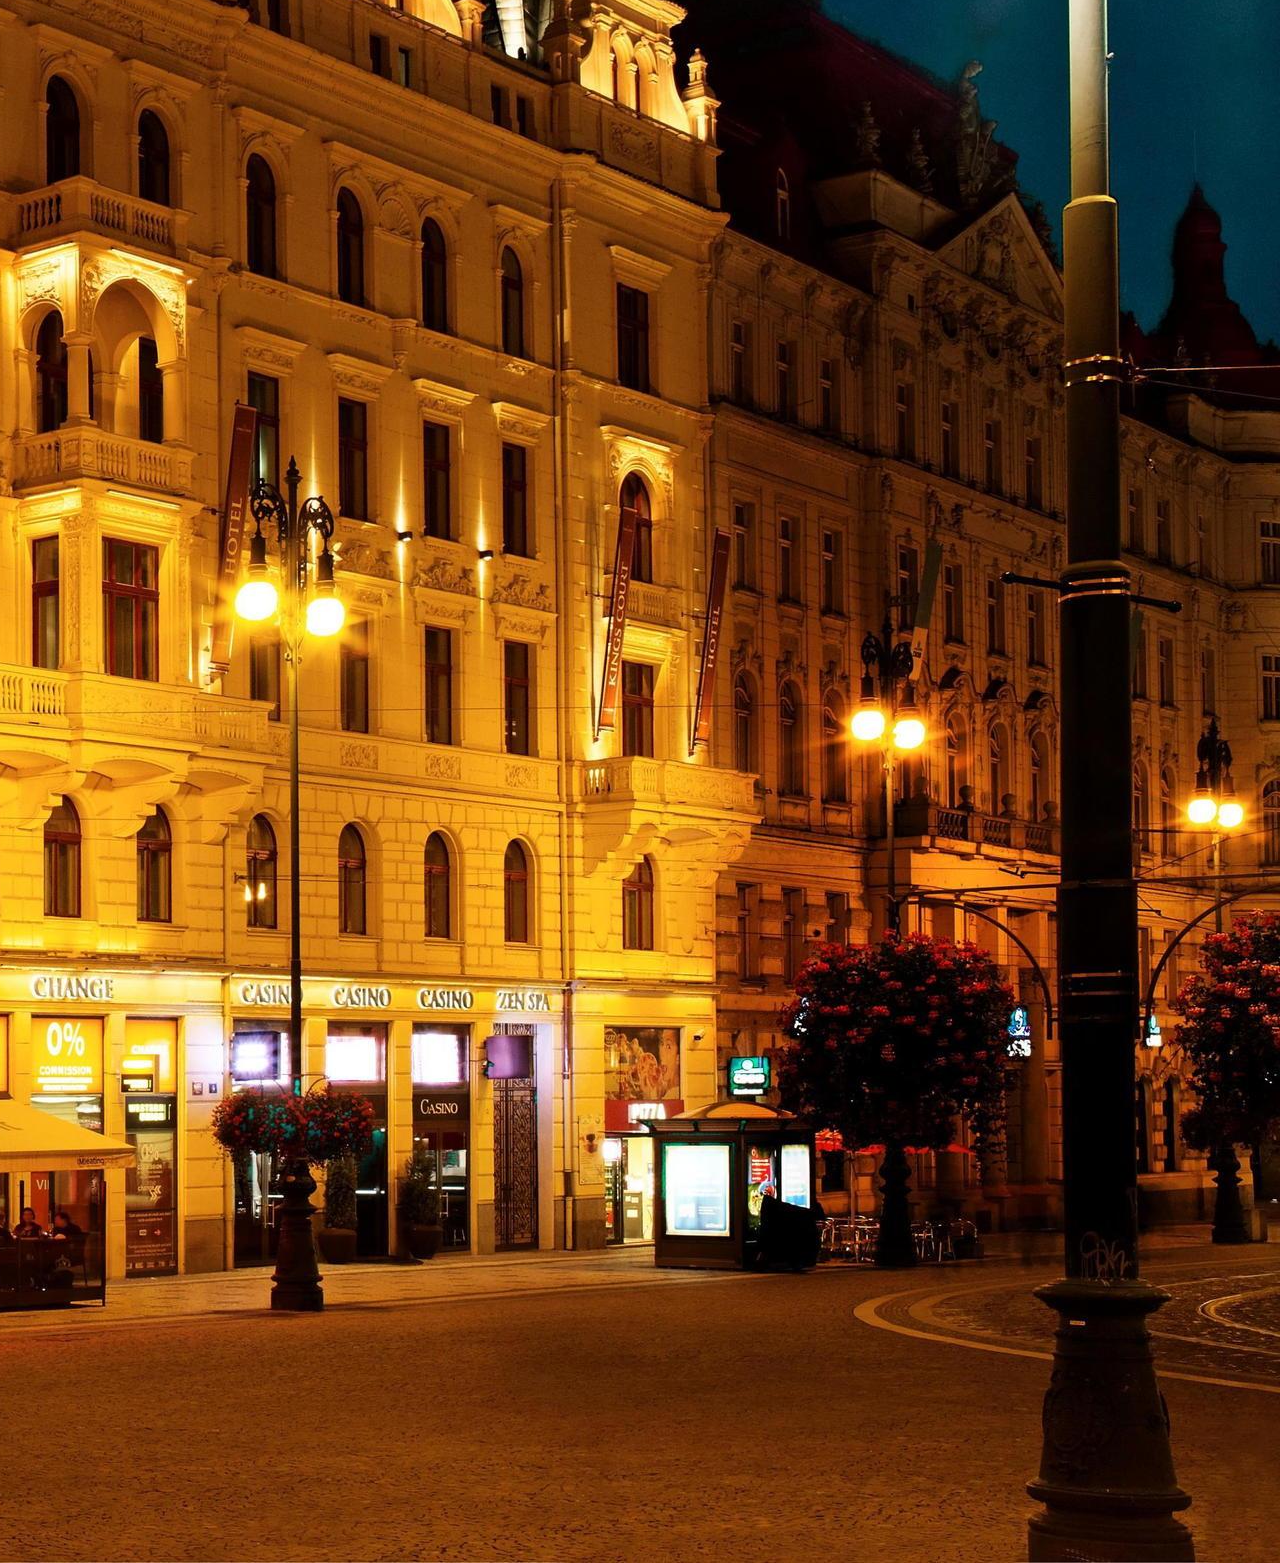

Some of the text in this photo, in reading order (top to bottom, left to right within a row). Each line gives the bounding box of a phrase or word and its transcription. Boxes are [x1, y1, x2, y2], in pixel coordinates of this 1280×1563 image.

[225, 497, 244, 575] HOTEL
[608, 564, 629, 687] KINGS COURT
[707, 606, 721, 668] HOTEL
[33, 976, 114, 1000] CHANGE
[241, 983, 302, 1005] CASIN
[334, 987, 392, 1008] CASINO
[420, 988, 474, 1009] CASINO
[496, 990, 551, 1011] ZEN SPA
[46, 1021, 86, 1057] 0%
[419, 1098, 459, 1116] CASINO
